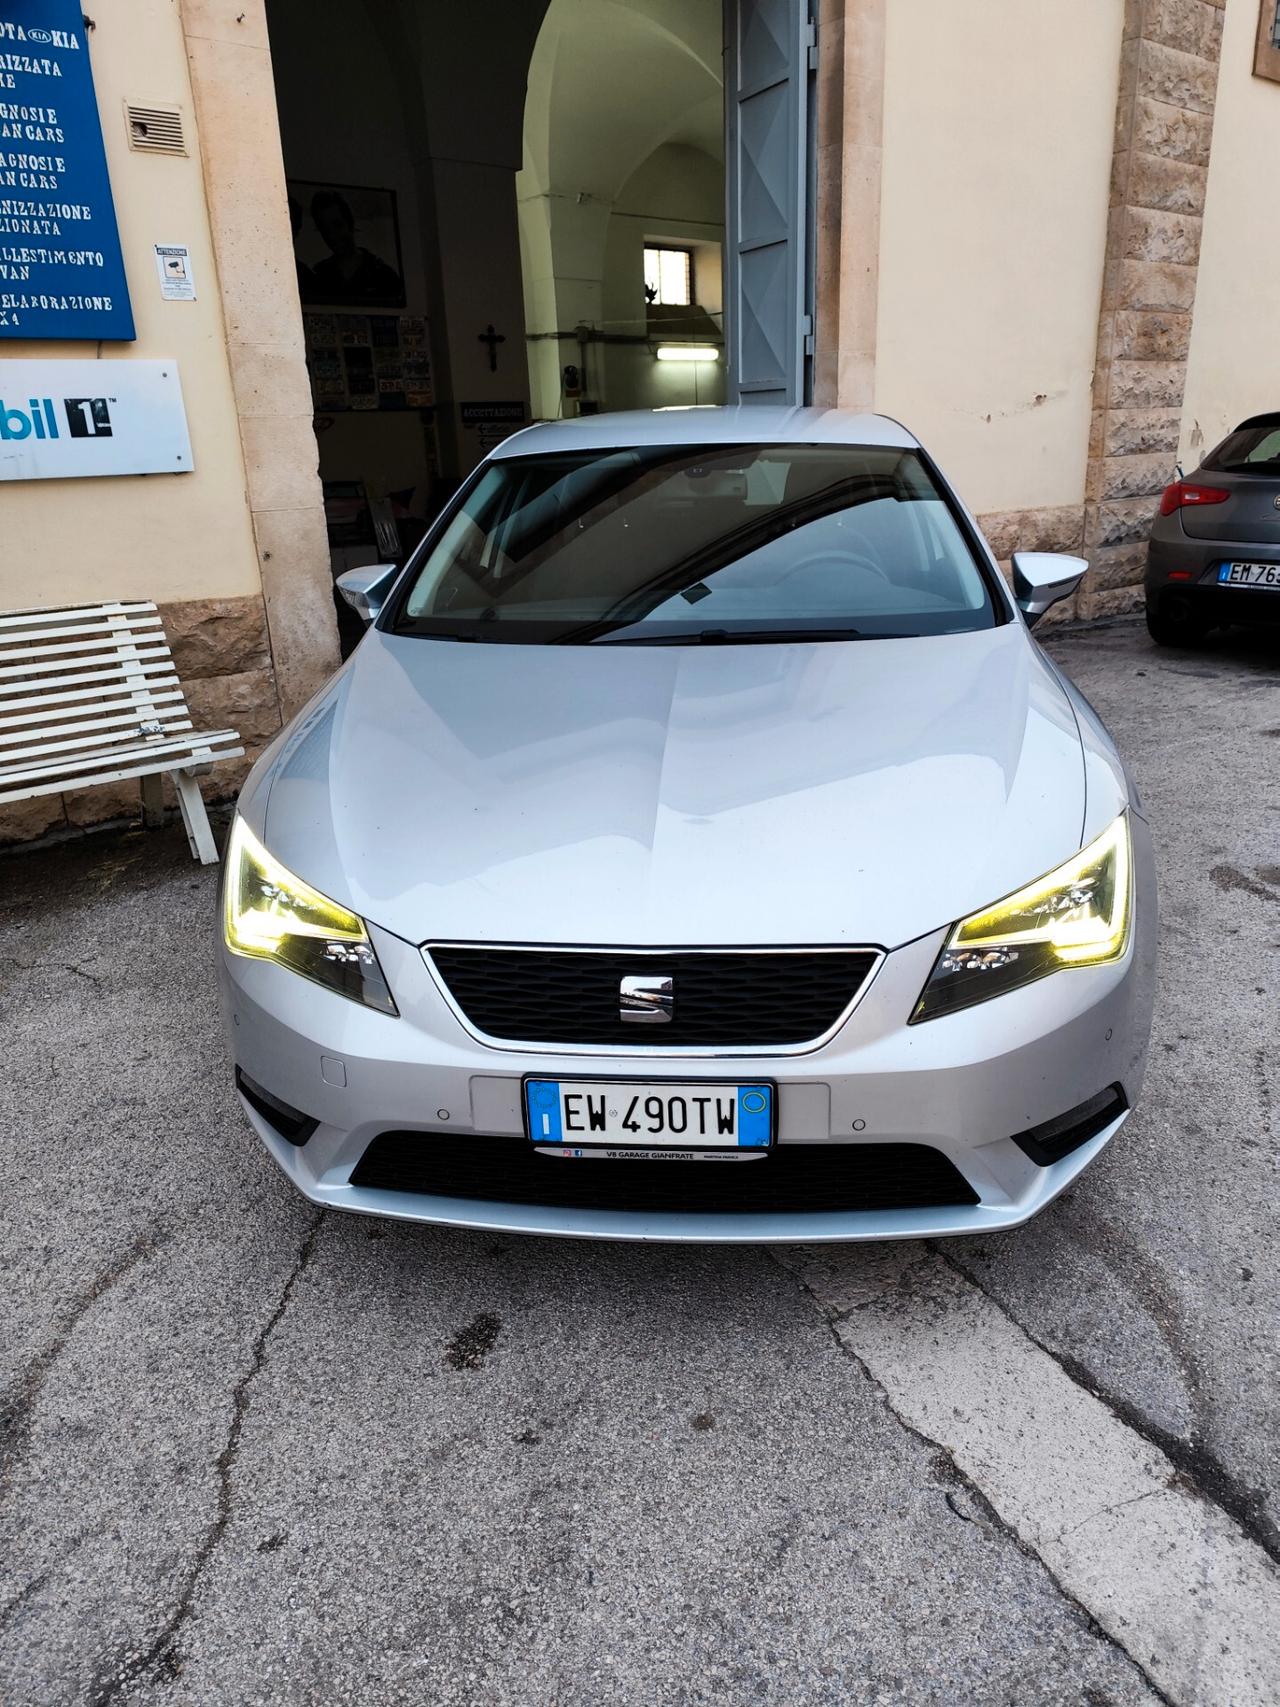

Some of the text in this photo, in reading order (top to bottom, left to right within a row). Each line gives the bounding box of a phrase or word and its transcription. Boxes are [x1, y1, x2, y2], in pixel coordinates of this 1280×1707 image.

[51, 30, 80, 49] KIA
[0, 123, 65, 144] AN CARS
[20, 172, 58, 189] CARS
[0, 199, 92, 220] NIZZAZIONE
[0, 247, 104, 267] LLESTIMENTO
[0, 399, 60, 440] bil
[1230, 564, 1252, 581] EM
[564, 1094, 606, 1131] EW
[621, 1096, 736, 1135] 490TW
[651, 1152, 694, 1160] GIANFRATE
